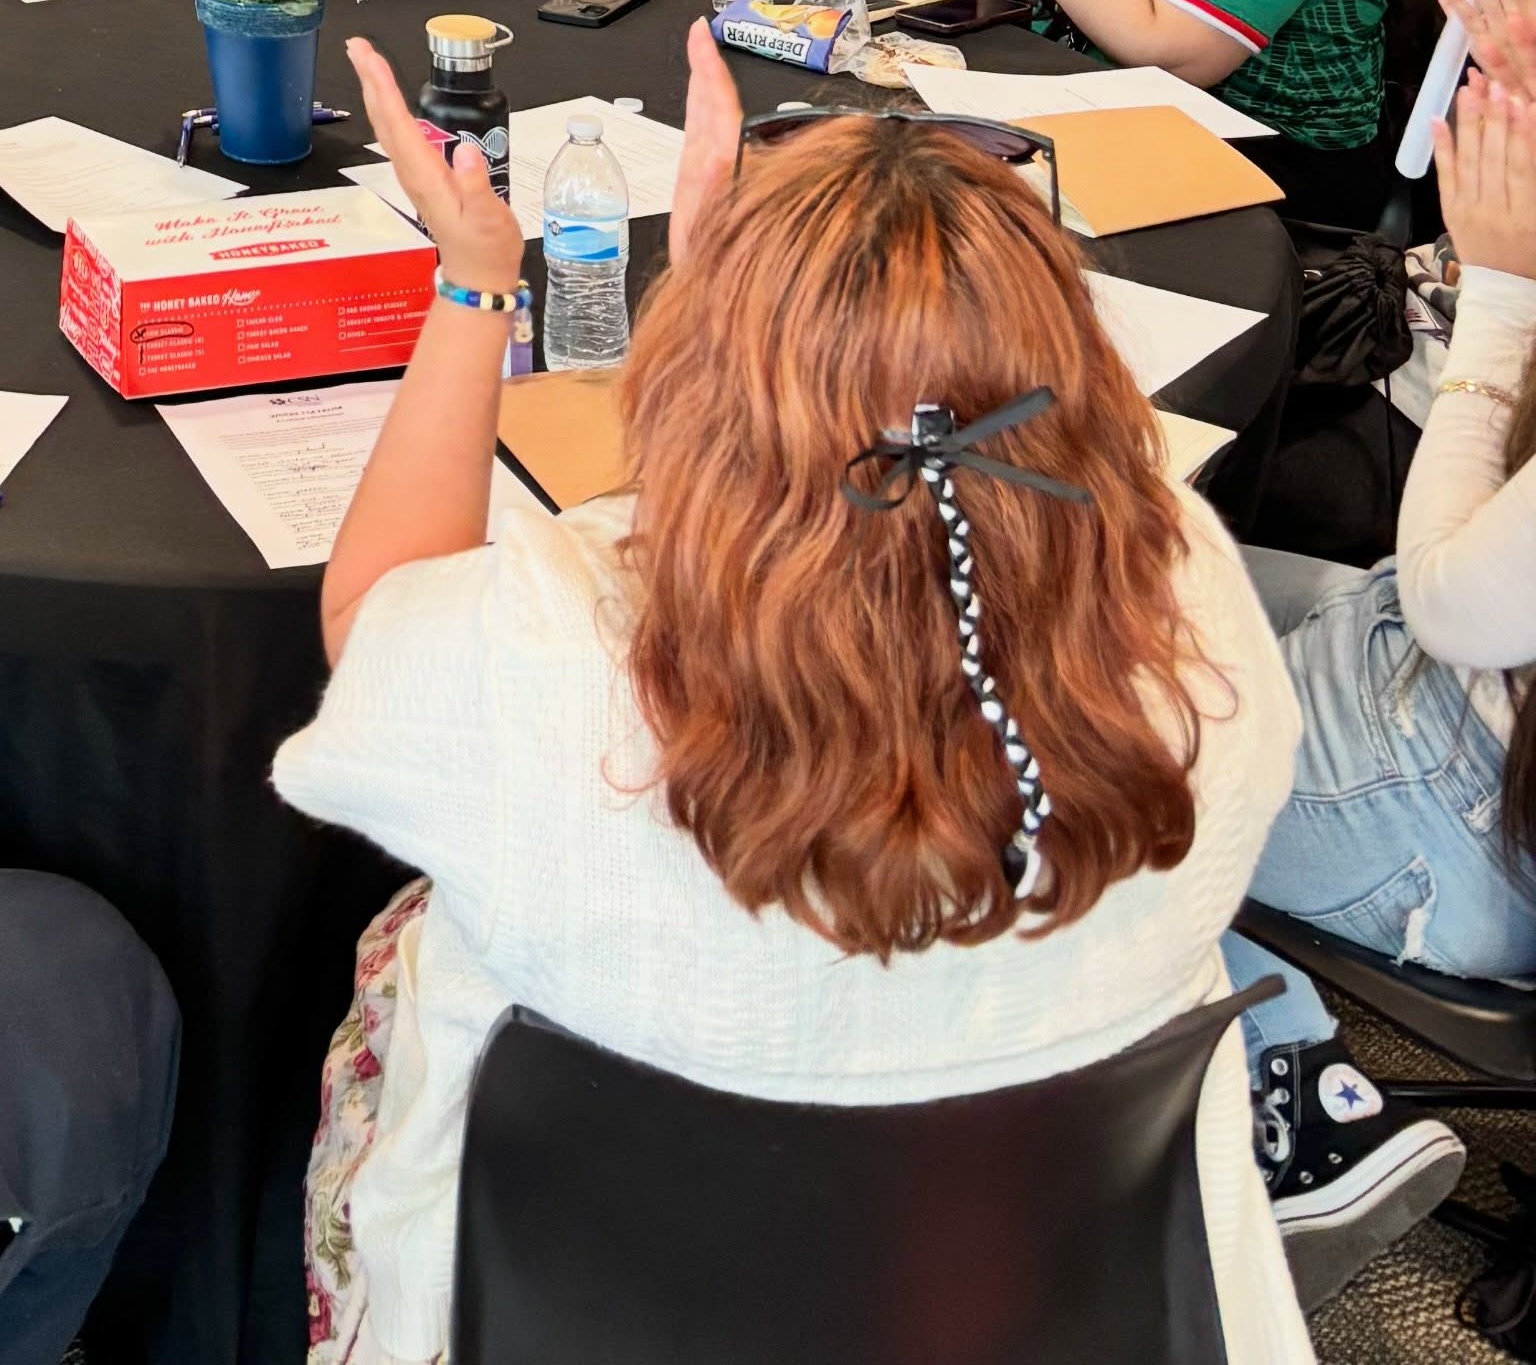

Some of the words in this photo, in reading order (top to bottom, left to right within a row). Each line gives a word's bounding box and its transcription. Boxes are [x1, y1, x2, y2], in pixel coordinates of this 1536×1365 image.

[727, 26, 767, 47] RIVER
[768, 37, 805, 57] DEEP
[154, 215, 217, 232] Make
[144, 231, 194, 246] with
[219, 241, 319, 260] HONEYBAKED
[153, 298, 186, 313] HONEY
[187, 294, 221, 309] BAKED
